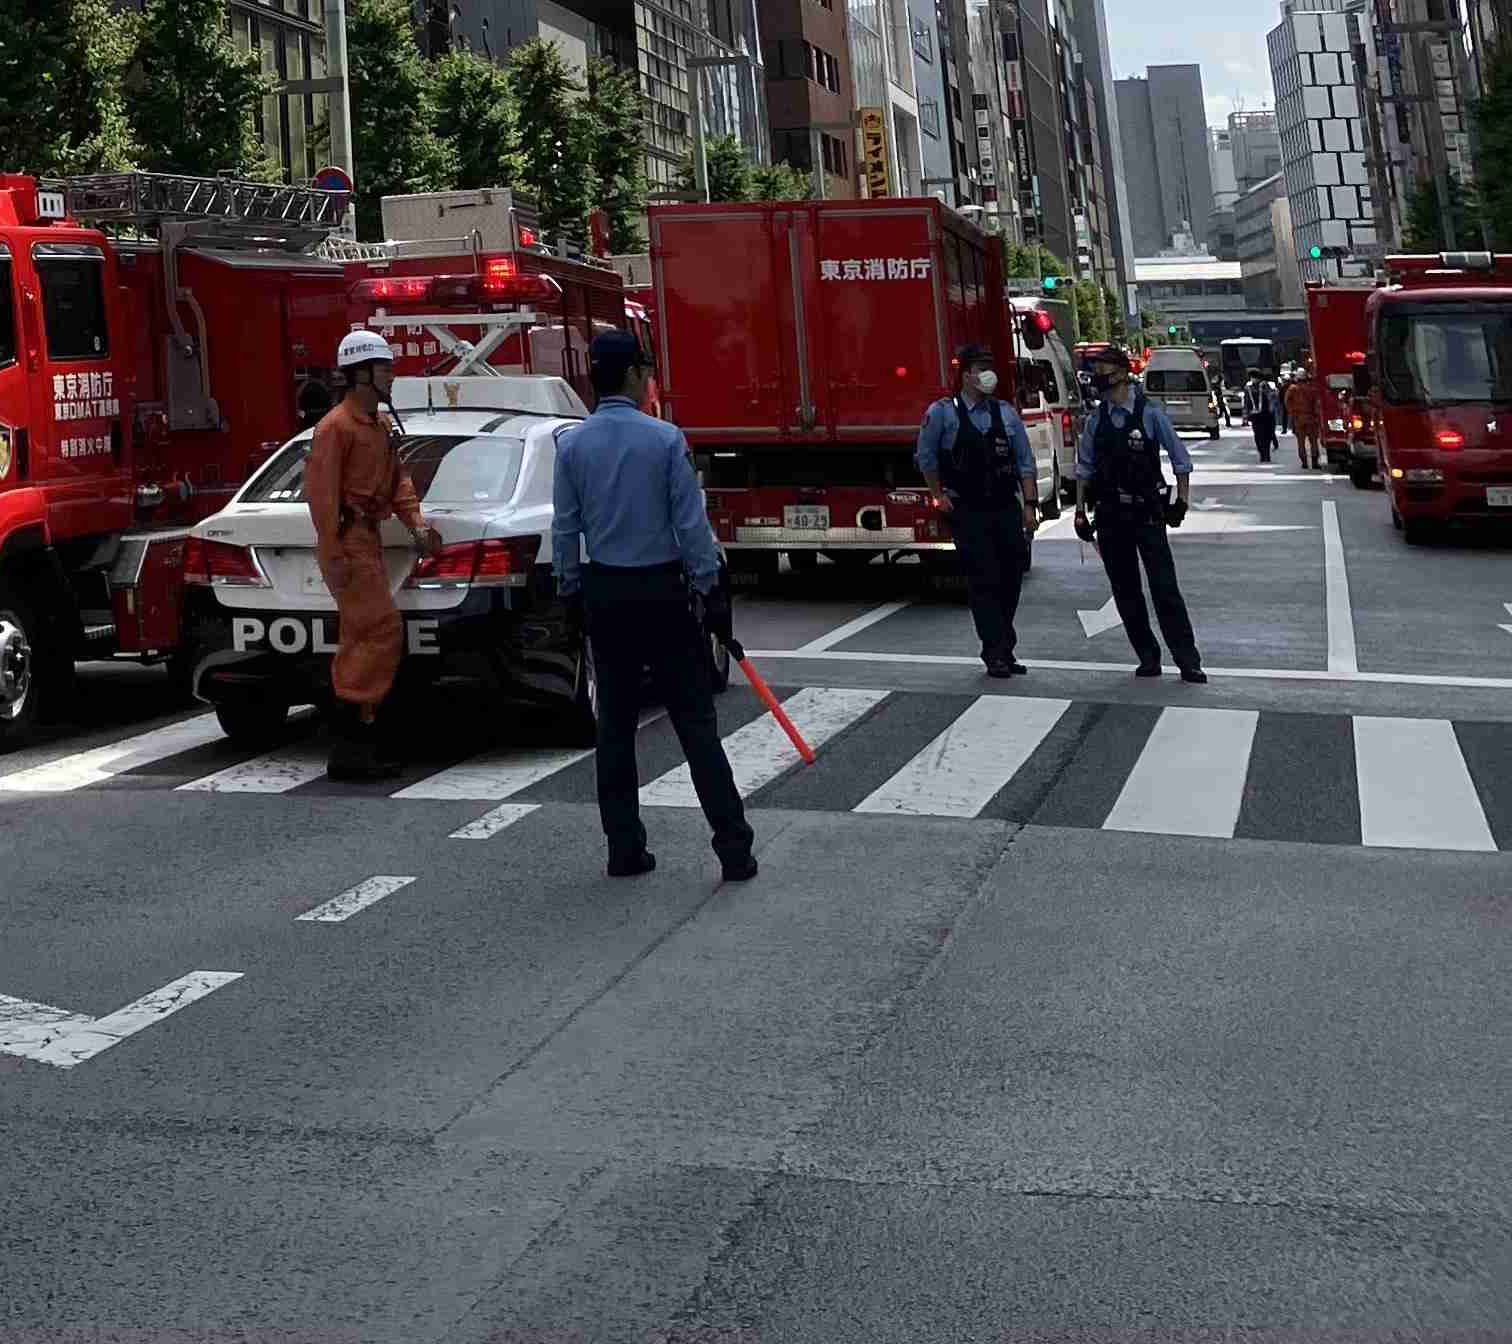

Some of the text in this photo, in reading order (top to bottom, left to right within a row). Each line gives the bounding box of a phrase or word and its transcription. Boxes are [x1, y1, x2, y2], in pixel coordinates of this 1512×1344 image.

[820, 257, 931, 281] 東京消防庁
[53, 372, 113, 400] 東京消防庁
[232, 617, 440, 655] POLE
